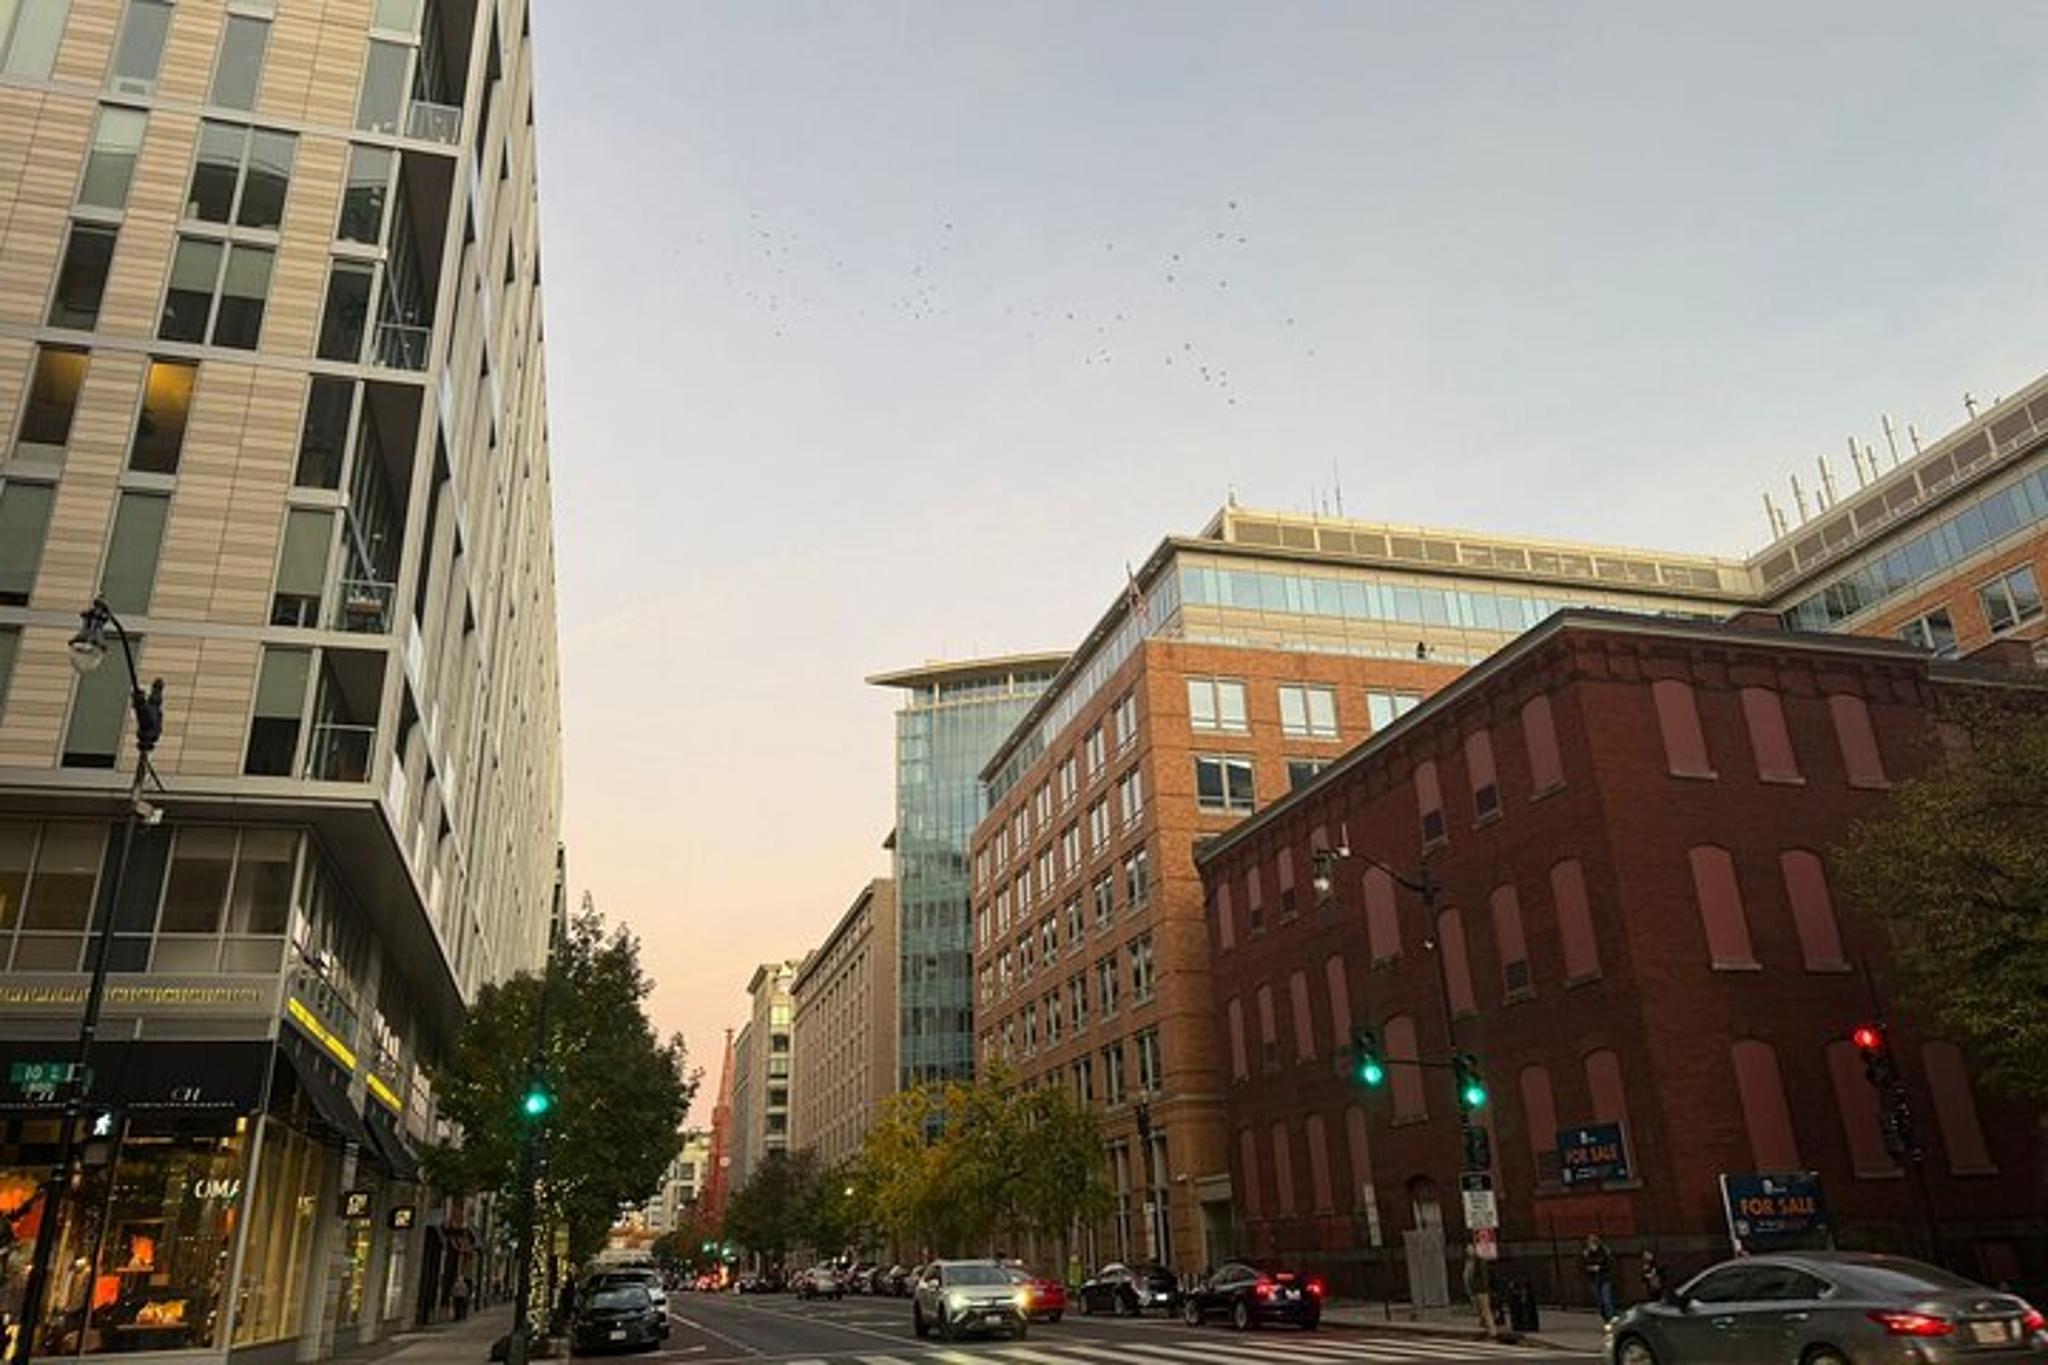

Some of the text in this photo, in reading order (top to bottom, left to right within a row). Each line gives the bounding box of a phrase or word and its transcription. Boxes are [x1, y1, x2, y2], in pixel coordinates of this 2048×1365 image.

[1566, 1143, 1617, 1165] FOR SALE
[1740, 1195, 1815, 1216] FOR SALE
